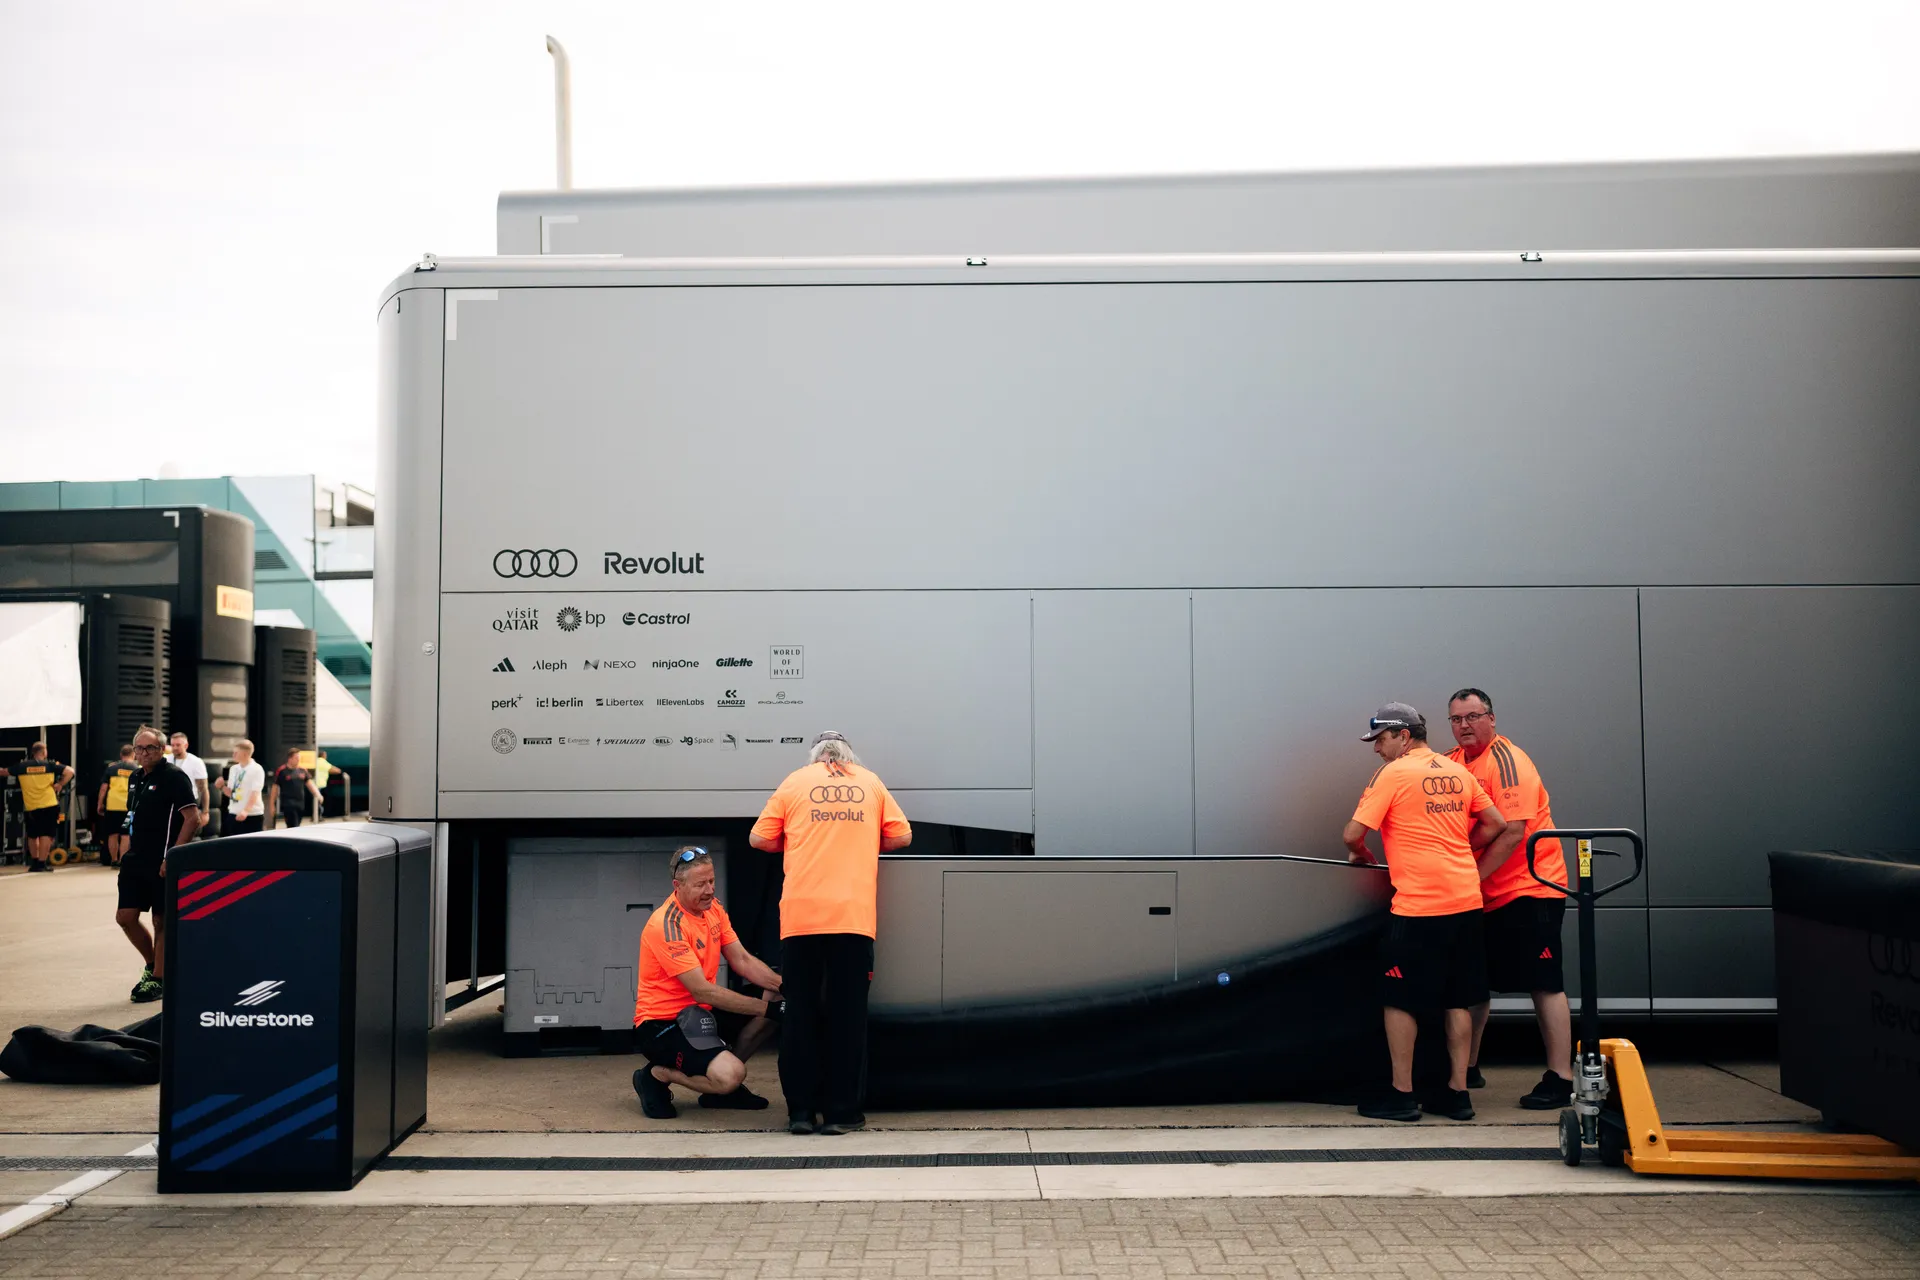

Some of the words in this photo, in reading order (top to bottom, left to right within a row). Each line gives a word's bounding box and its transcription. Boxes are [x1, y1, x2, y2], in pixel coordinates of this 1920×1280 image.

[604, 551, 704, 574] Revolut
[506, 607, 540, 619] visit
[585, 610, 606, 629] bp
[637, 612, 691, 626] Castrol
[492, 619, 539, 633] QATAR
[532, 659, 568, 673] Aleph
[603, 660, 637, 669] NEXO
[652, 659, 700, 671] ninjaOne
[715, 657, 753, 668] Gillette
[773, 668, 800, 676] HYATT
[552, 697, 584, 708] berlin
[605, 698, 645, 707] Libertex
[523, 737, 553, 745] PIRELLI
[1426, 800, 1464, 814] Revolut
[811, 808, 865, 822] Revolut
[200, 1011, 314, 1028] Silverstone
